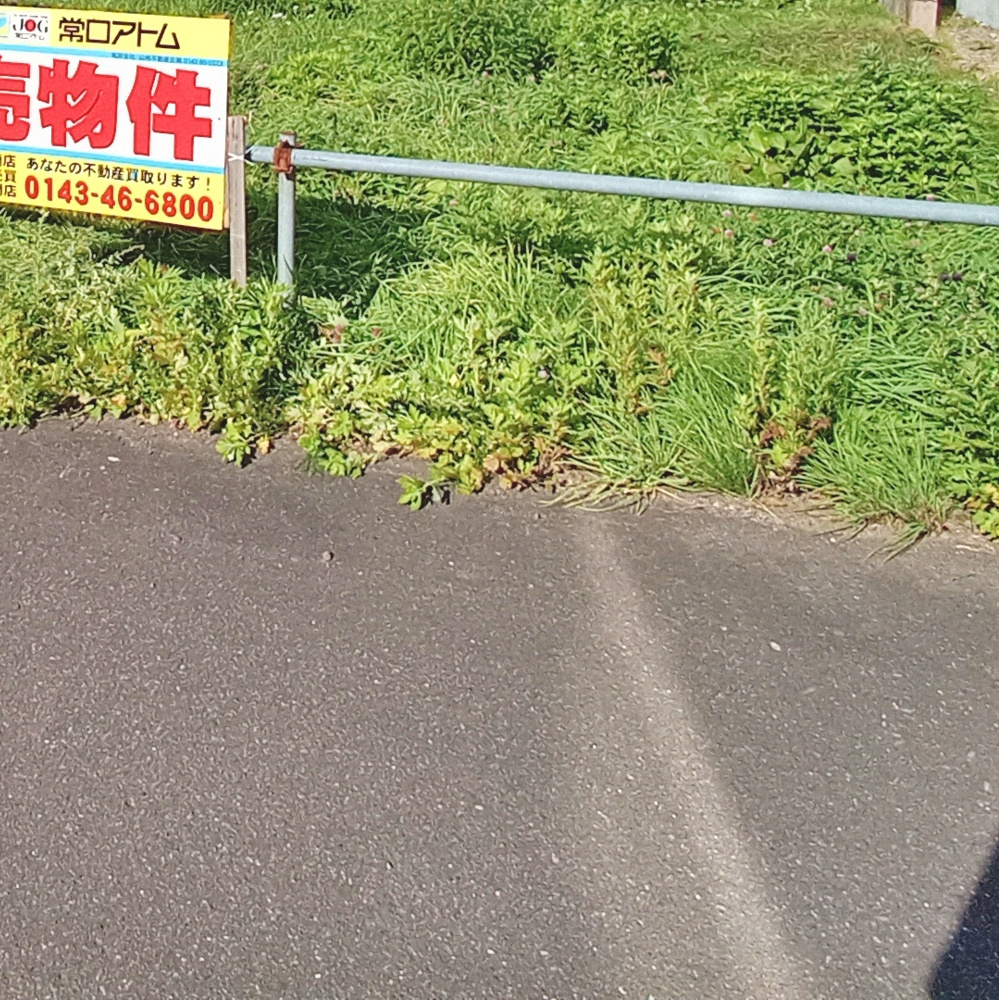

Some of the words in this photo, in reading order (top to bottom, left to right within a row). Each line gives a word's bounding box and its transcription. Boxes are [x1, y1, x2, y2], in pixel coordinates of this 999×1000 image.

[58, 17, 181, 49] 常口アトム
[24, 175, 214, 222] 0143-46-6800
